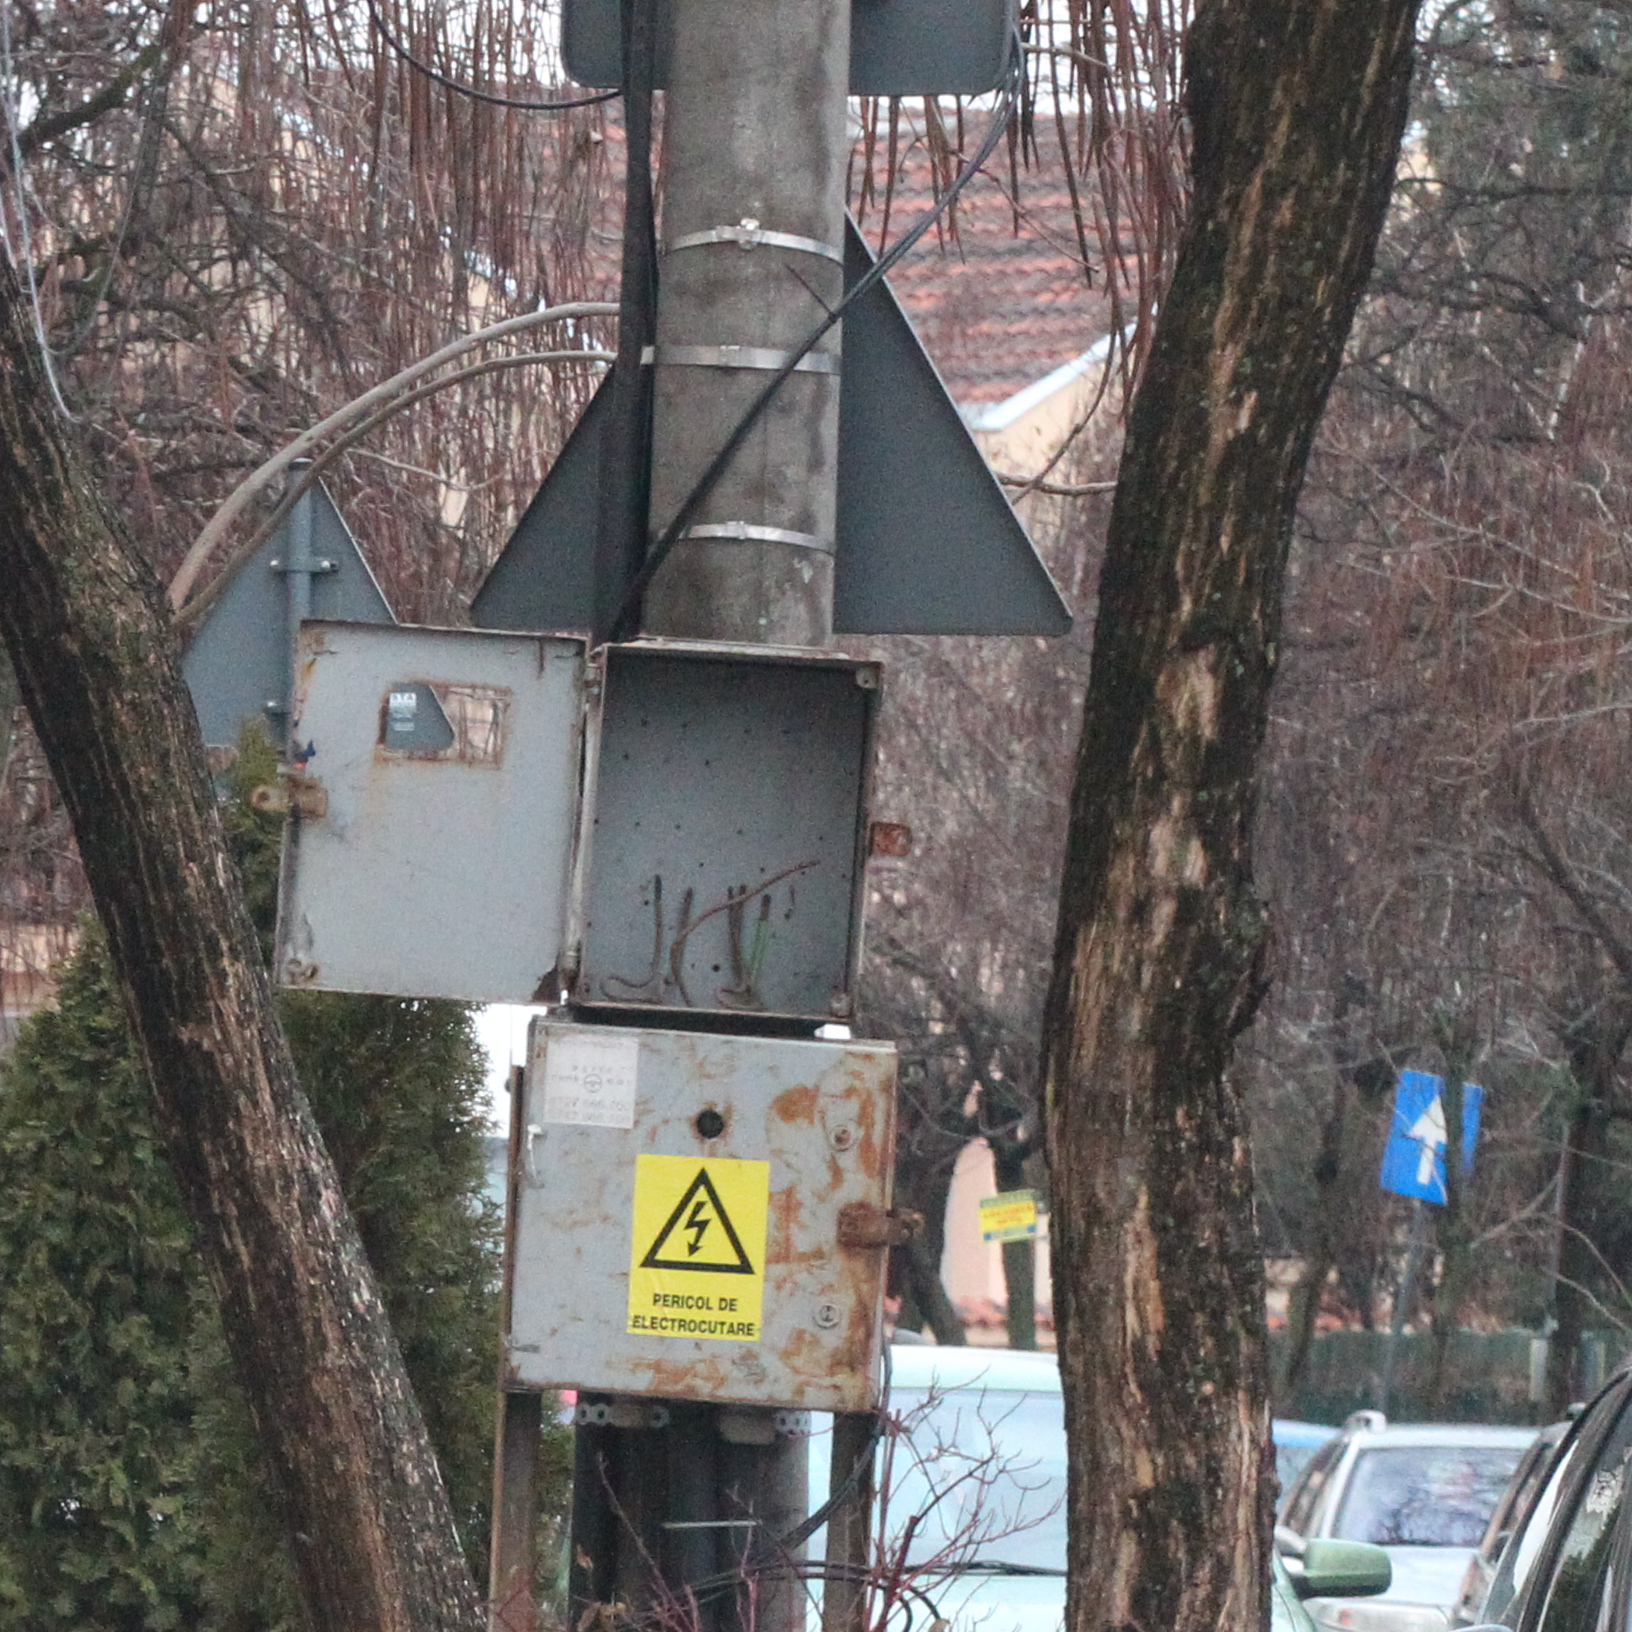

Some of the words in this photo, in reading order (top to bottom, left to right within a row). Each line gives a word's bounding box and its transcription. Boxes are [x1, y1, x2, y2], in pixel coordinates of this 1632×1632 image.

[653, 1292, 713, 1311] PERICOL
[718, 1297, 738, 1312] DE
[632, 1314, 756, 1337] ELECTROCUTARE
